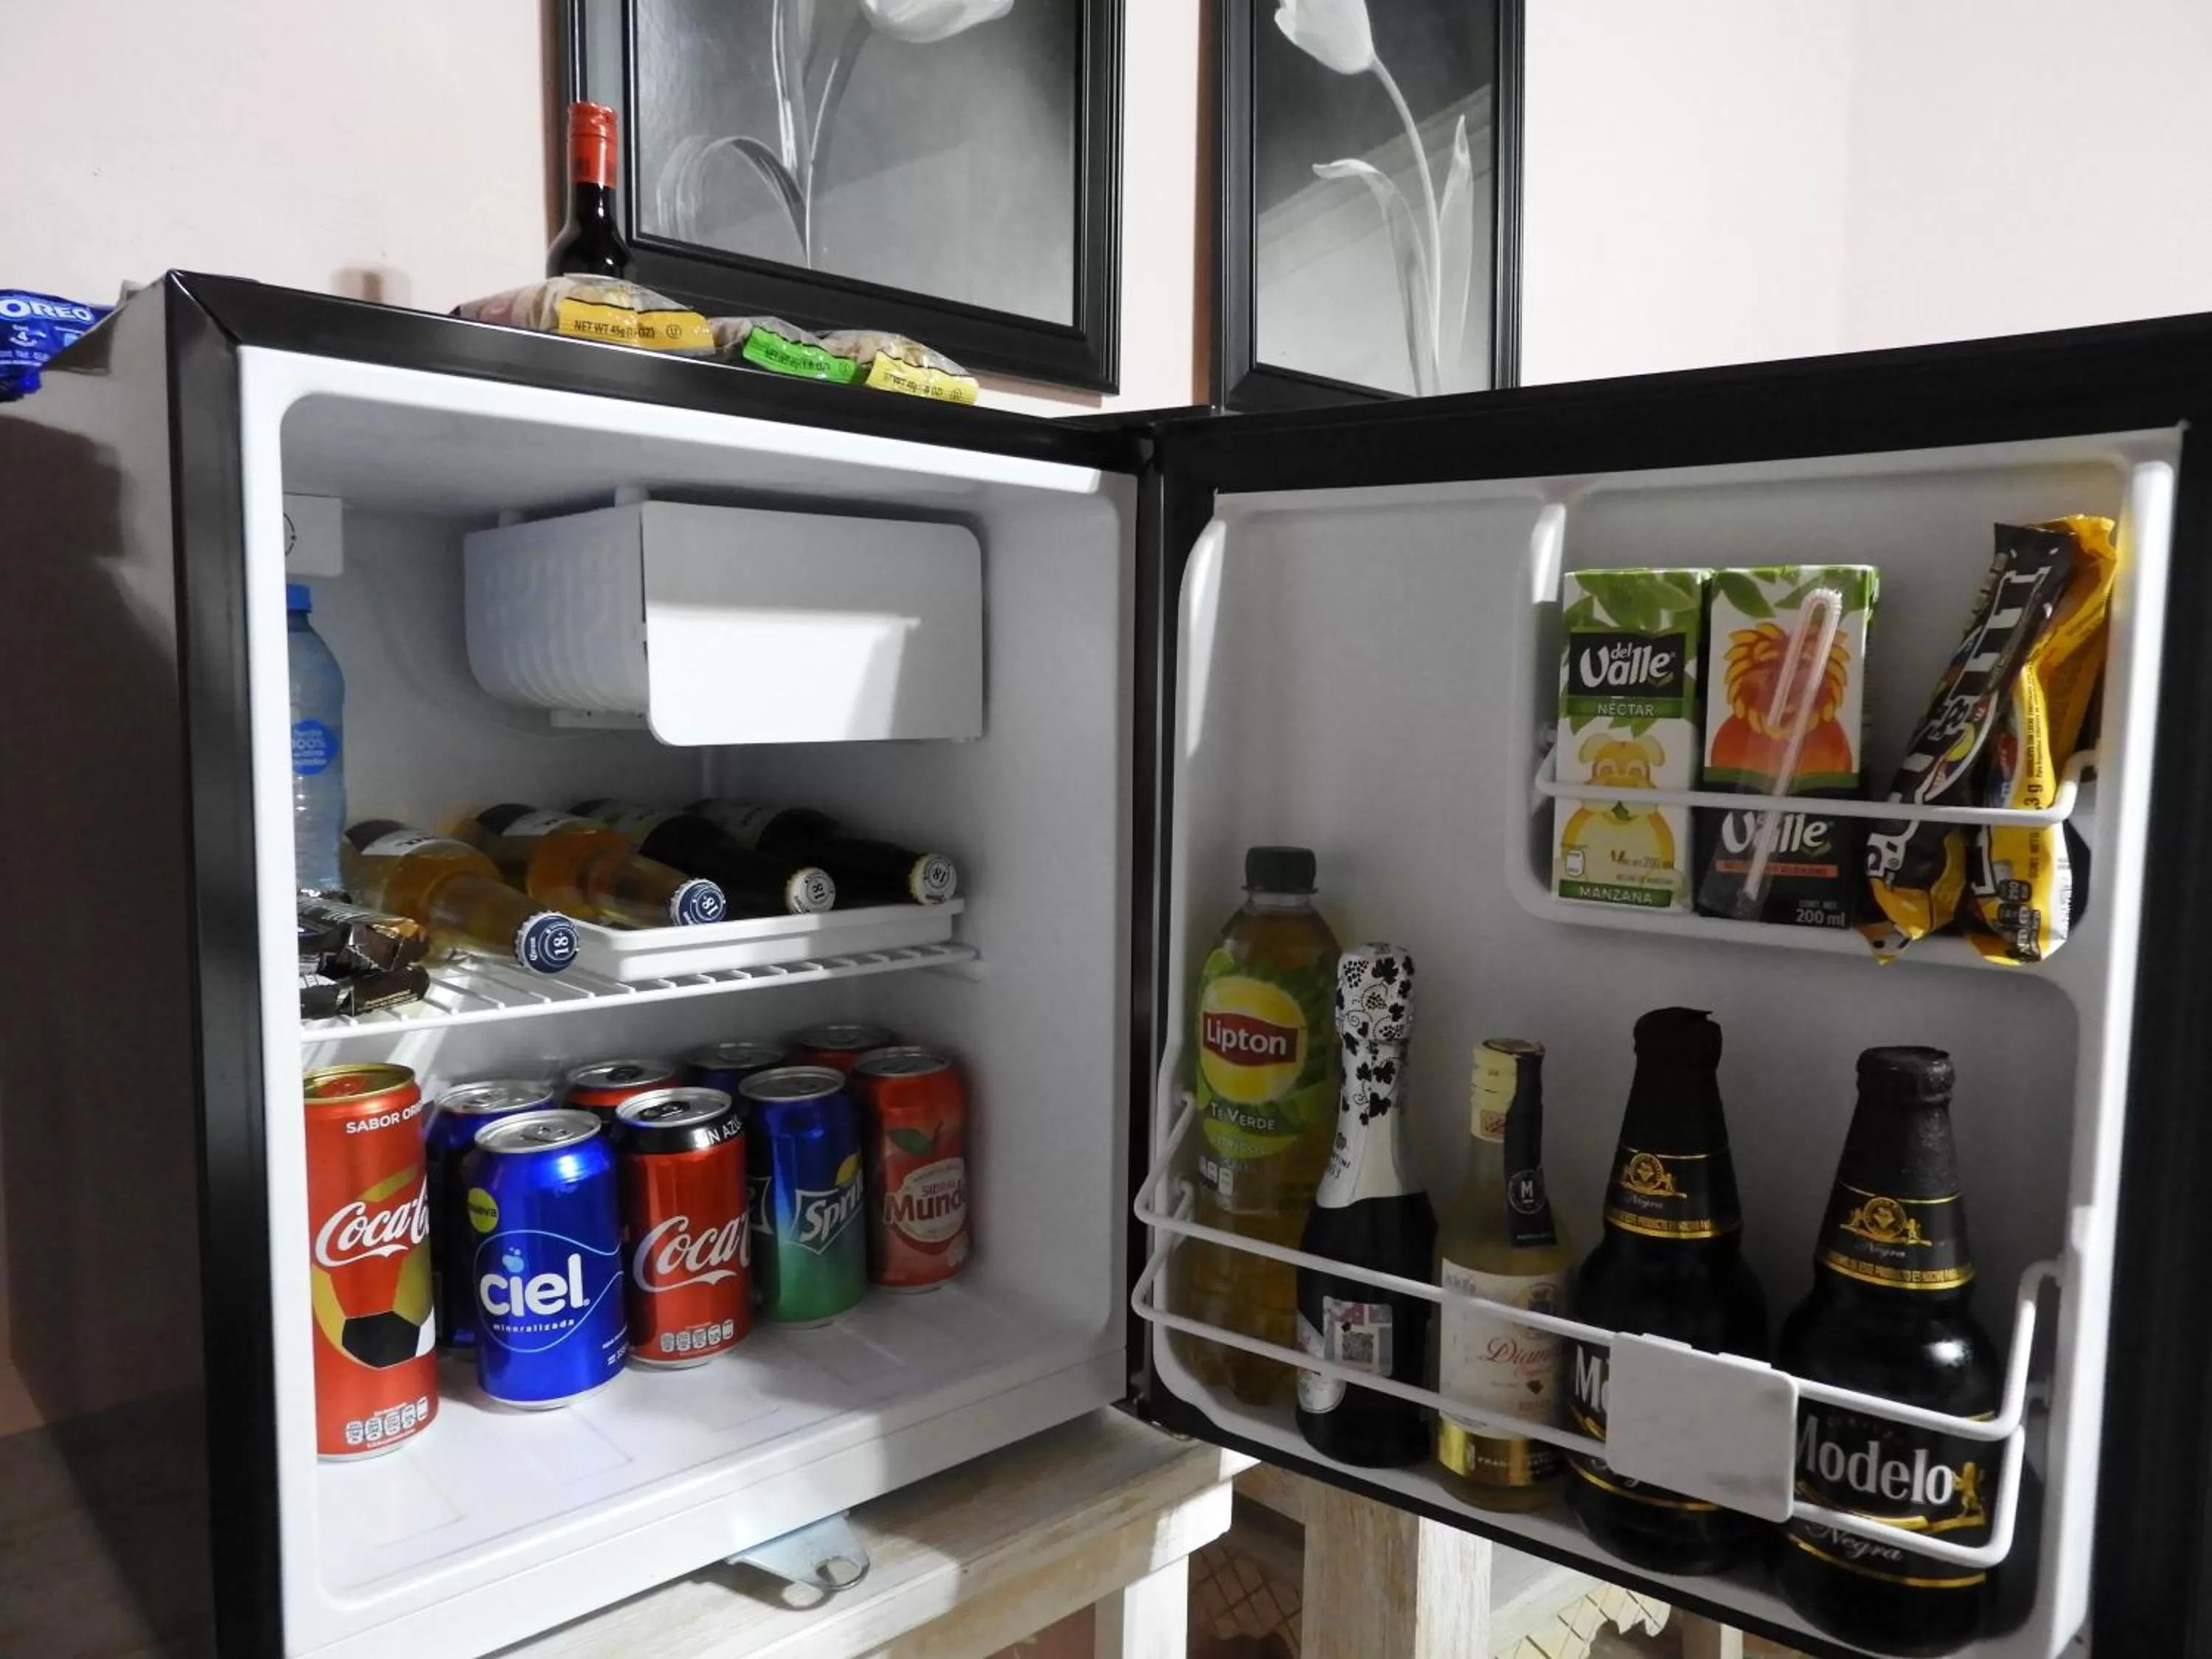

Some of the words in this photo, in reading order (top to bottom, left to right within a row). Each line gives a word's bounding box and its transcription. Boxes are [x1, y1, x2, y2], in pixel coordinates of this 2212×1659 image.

[0, 299, 94, 321] OREO
[1610, 642, 1632, 659] del
[1580, 645, 1671, 688] Valle
[1579, 886, 1653, 905] MANZANA
[1795, 908, 1825, 923] 200
[1827, 910, 1846, 928] ml
[1206, 1018, 1287, 1056] Lipton
[346, 1112, 400, 1134] SABOR
[1227, 1107, 1275, 1131] VERDE
[480, 1245, 584, 1318] ciel
